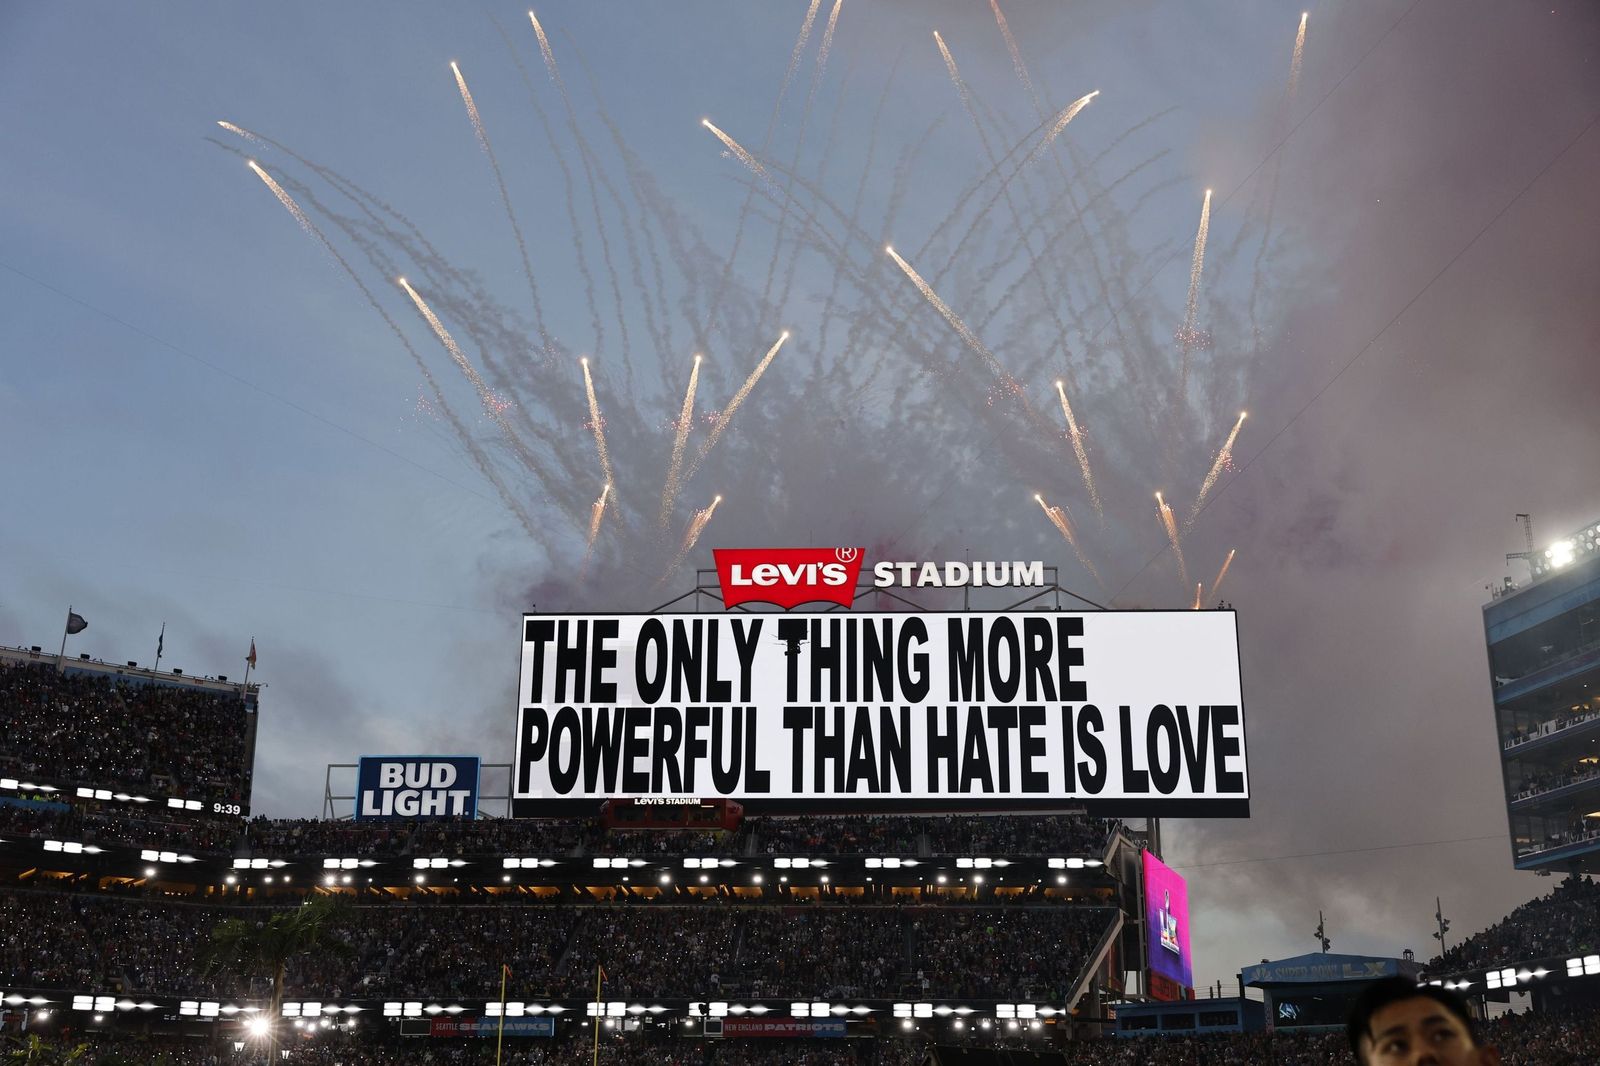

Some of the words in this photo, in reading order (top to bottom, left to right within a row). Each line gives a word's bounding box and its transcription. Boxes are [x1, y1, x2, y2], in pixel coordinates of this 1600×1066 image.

[874, 560, 1044, 588] STADIUM
[525, 619, 619, 704] THE
[635, 617, 764, 704] ONLY
[778, 617, 930, 704] THING
[947, 616, 1088, 703] MORE
[518, 706, 771, 795] POWERFUL
[783, 706, 911, 793] THAN
[926, 705, 1050, 793] HATE
[1061, 704, 1107, 794] IS
[1119, 704, 1245, 795] LOVE
[380, 762, 457, 788] BUD
[213, 802, 241, 815] 9:39
[361, 789, 470, 816] LIGHT
[1342, 961, 1388, 979] LX
[724, 1023, 738, 1031] NEW
[738, 1023, 763, 1031] ENGLAND
[764, 1023, 845, 1031] PATRIOTS
